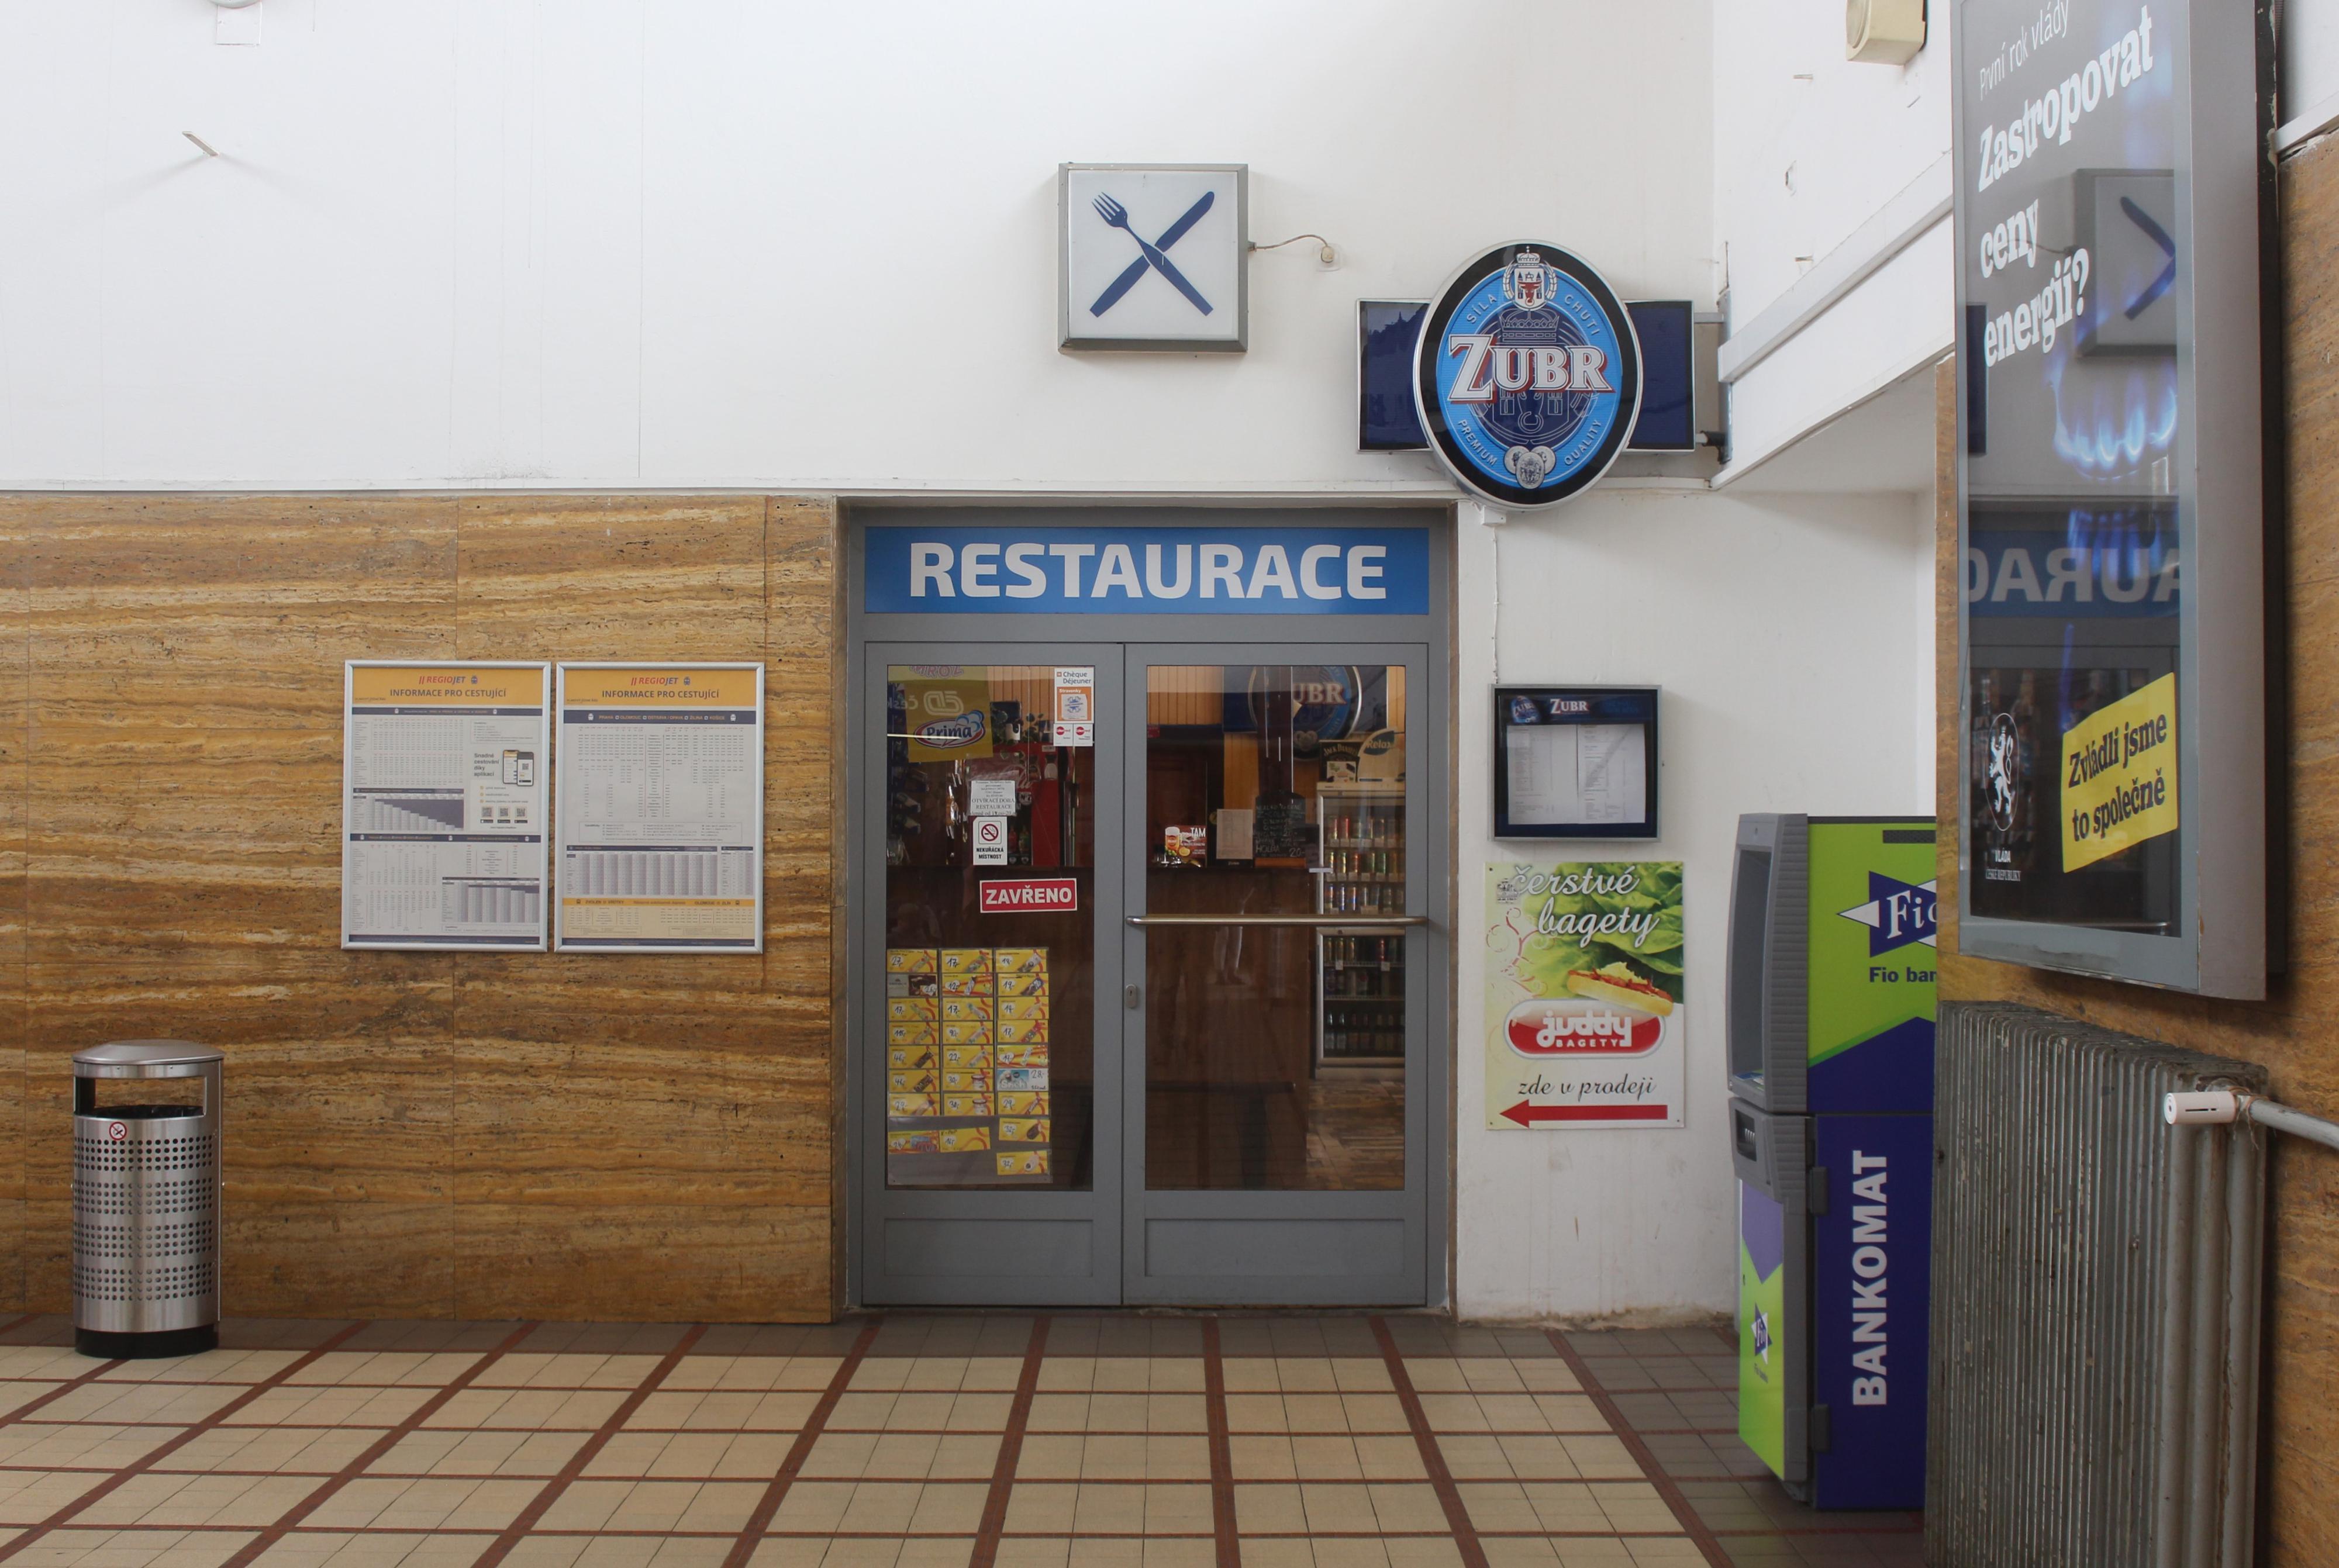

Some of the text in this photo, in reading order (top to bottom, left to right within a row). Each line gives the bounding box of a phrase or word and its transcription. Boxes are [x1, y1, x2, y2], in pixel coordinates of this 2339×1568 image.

[1980, 0, 2069, 102] První rok vlády
[1978, 4, 2154, 192] Zastropovat
[1980, 198, 2038, 278] ceny
[1466, 293, 1600, 336] SÍLA CHUTI
[1984, 248, 2089, 367] energií?
[1447, 333, 1616, 405] ZUBR
[1458, 419, 1602, 467] PREMIUM QUALITY
[910, 543, 1388, 600] RESTAURACE
[389, 689, 443, 697] INFORMACE
[464, 688, 506, 698] CESTUJÍCÍ
[426, 676, 466, 685] REGIOJET
[602, 690, 655, 698] INFORMACE
[678, 688, 720, 699] CESTUJÍCÍ
[638, 677, 678, 685] REGIOJET
[1550, 698, 1589, 714] ZUBR
[926, 725, 972, 741] Prima
[1368, 740, 1392, 749] Relax
[2068, 714, 2167, 789] Zvládli jsme
[2072, 766, 2165, 842] to společně
[985, 885, 1072, 906] ZAVŘENO
[1511, 865, 1640, 896] čerstvé
[1538, 896, 1660, 948] bagety
[1869, 966, 1899, 983] Fio
[1536, 1009, 1632, 1048] juddy
[1556, 1039, 1618, 1048] BAGETY
[1517, 1072, 1657, 1103] zde v prodeji
[1852, 1149, 1888, 1405] BANKOMAT
